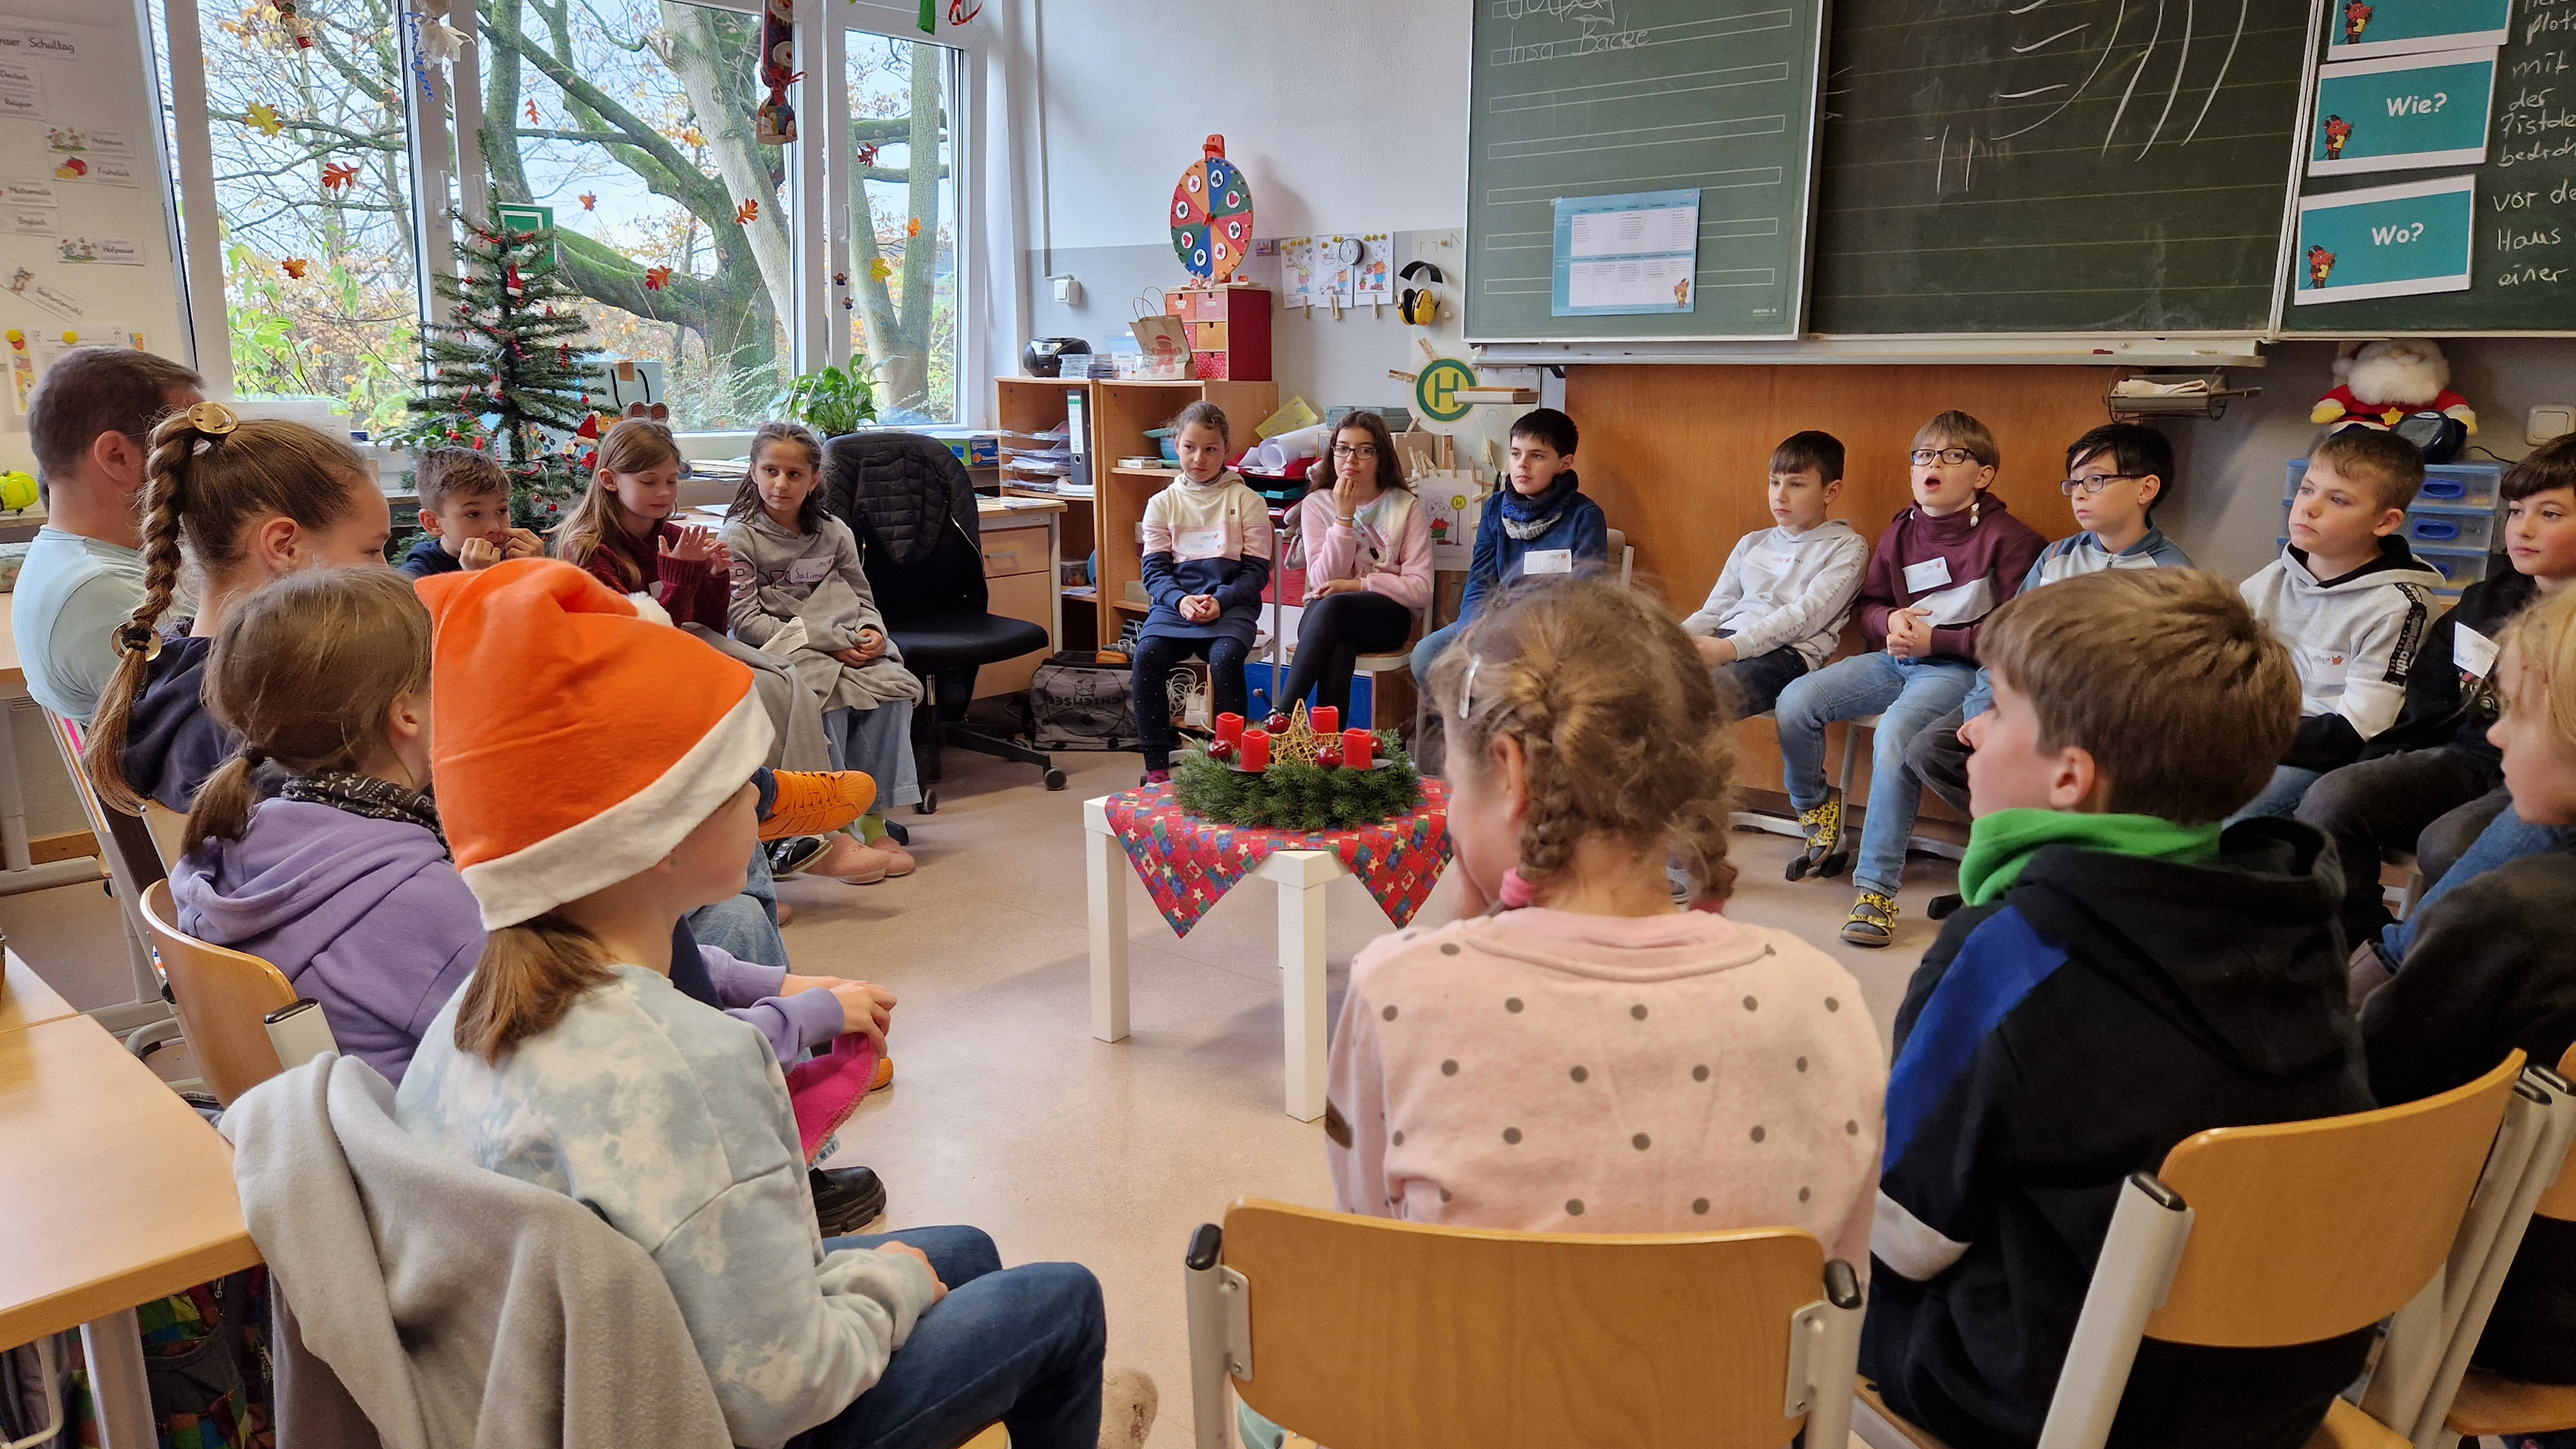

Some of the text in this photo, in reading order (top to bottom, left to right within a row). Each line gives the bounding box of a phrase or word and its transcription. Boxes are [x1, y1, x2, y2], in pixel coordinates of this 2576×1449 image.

[29, 37, 75, 54] Schultag
[1509, 26, 1554, 64] Insa
[1572, 12, 1651, 56] Backe
[2512, 50, 2571, 77] mit
[2386, 93, 2447, 117] Wie?
[2509, 87, 2556, 111] der
[2493, 191, 2539, 212] vor
[2371, 223, 2424, 246] Wo?
[2498, 228, 2561, 252] Haus
[102, 246, 134, 255] Hofpause
[2498, 264, 2570, 286] einer
[1434, 372, 1459, 408] H
[1047, 695, 1121, 707] CHIEMSEE
